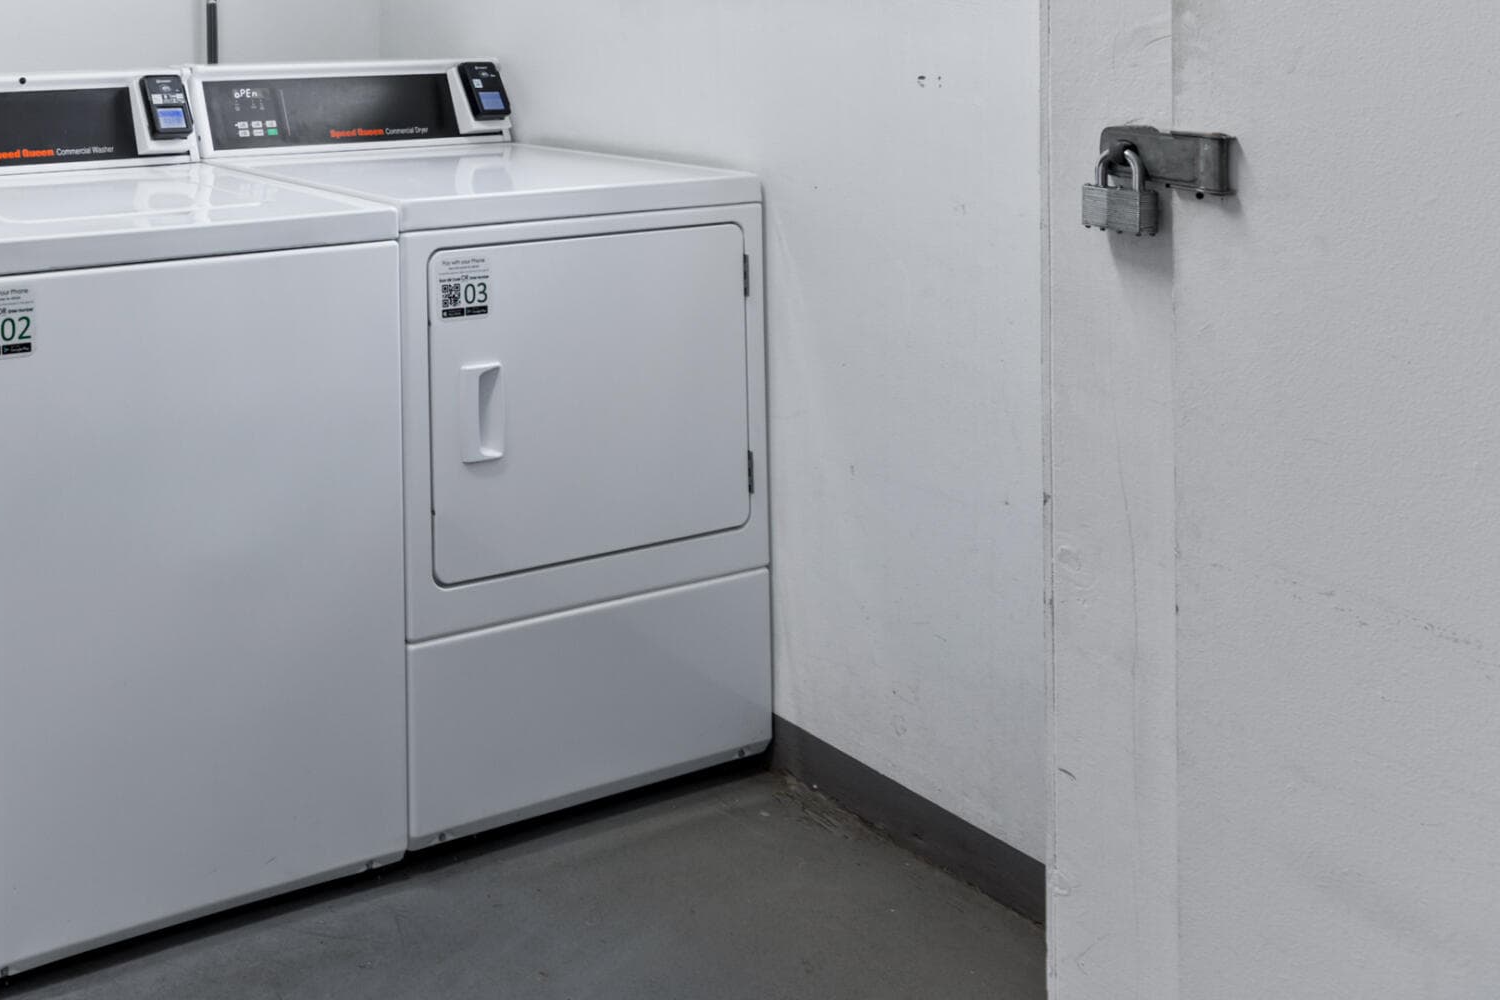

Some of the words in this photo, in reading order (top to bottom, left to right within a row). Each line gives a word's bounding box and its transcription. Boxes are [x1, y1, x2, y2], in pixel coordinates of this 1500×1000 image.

[22, 148, 55, 158] Queen
[55, 147, 91, 156] Commercial
[92, 146, 114, 154] Washer
[464, 282, 488, 305] 03
[1, 316, 32, 342] 02
